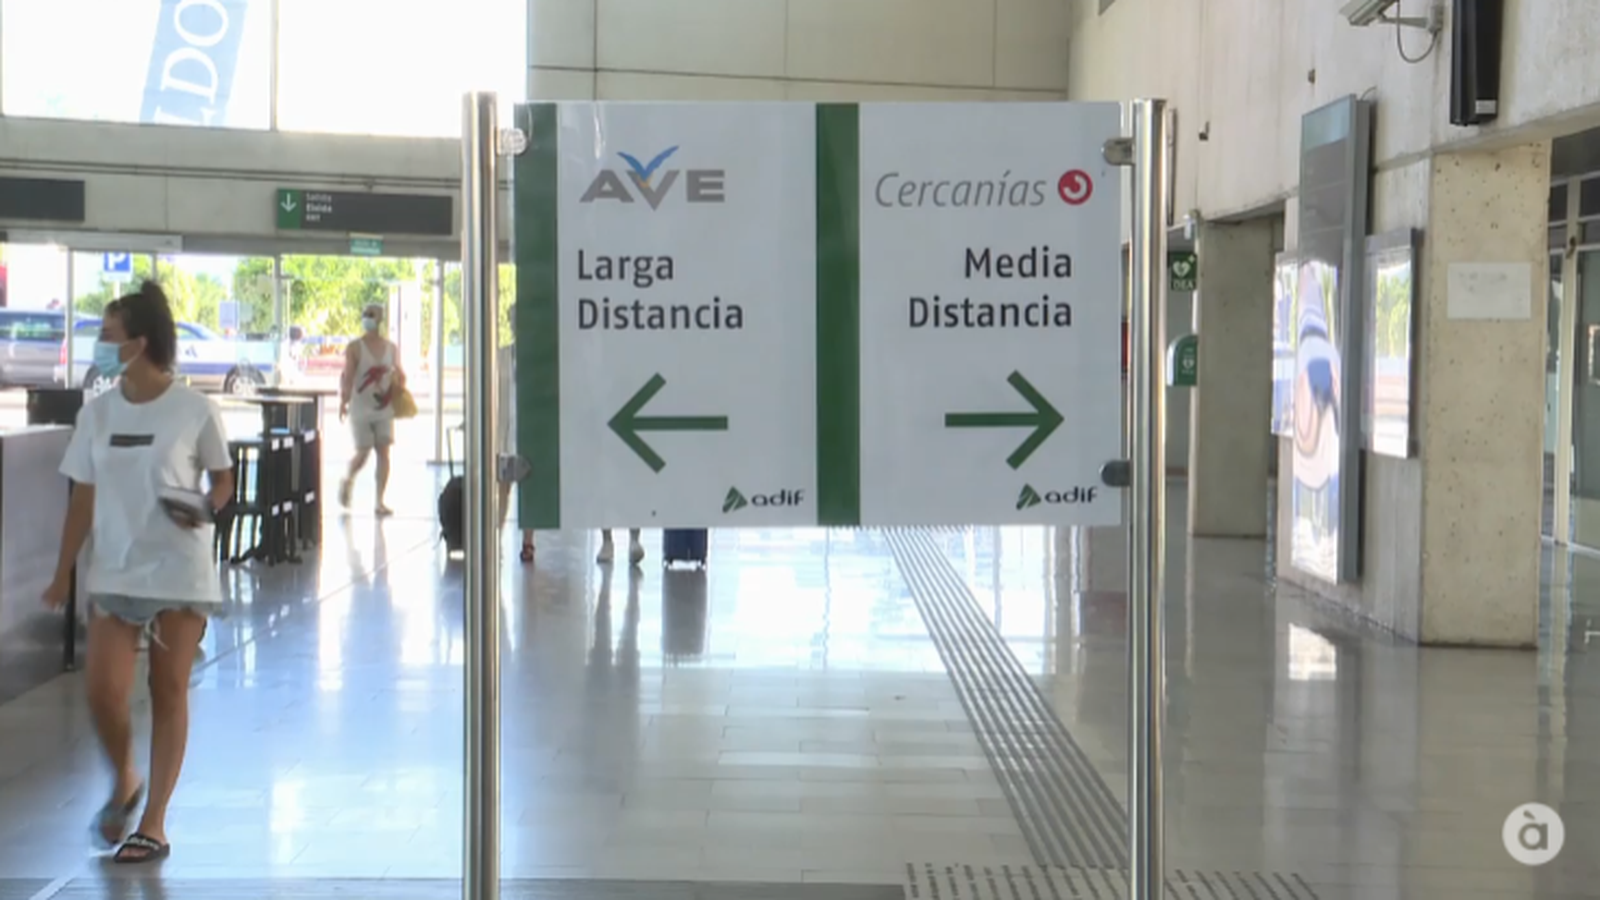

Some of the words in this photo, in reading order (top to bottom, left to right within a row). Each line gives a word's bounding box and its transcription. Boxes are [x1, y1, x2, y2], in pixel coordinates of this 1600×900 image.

[580, 145, 725, 210] AVE
[875, 169, 1047, 208] Cercanías
[578, 249, 674, 288] Larga
[965, 245, 1072, 279] Media
[578, 296, 743, 330] Distancia
[908, 294, 1072, 328] Distancia
[752, 488, 804, 507] adif
[1044, 485, 1097, 504] adif
